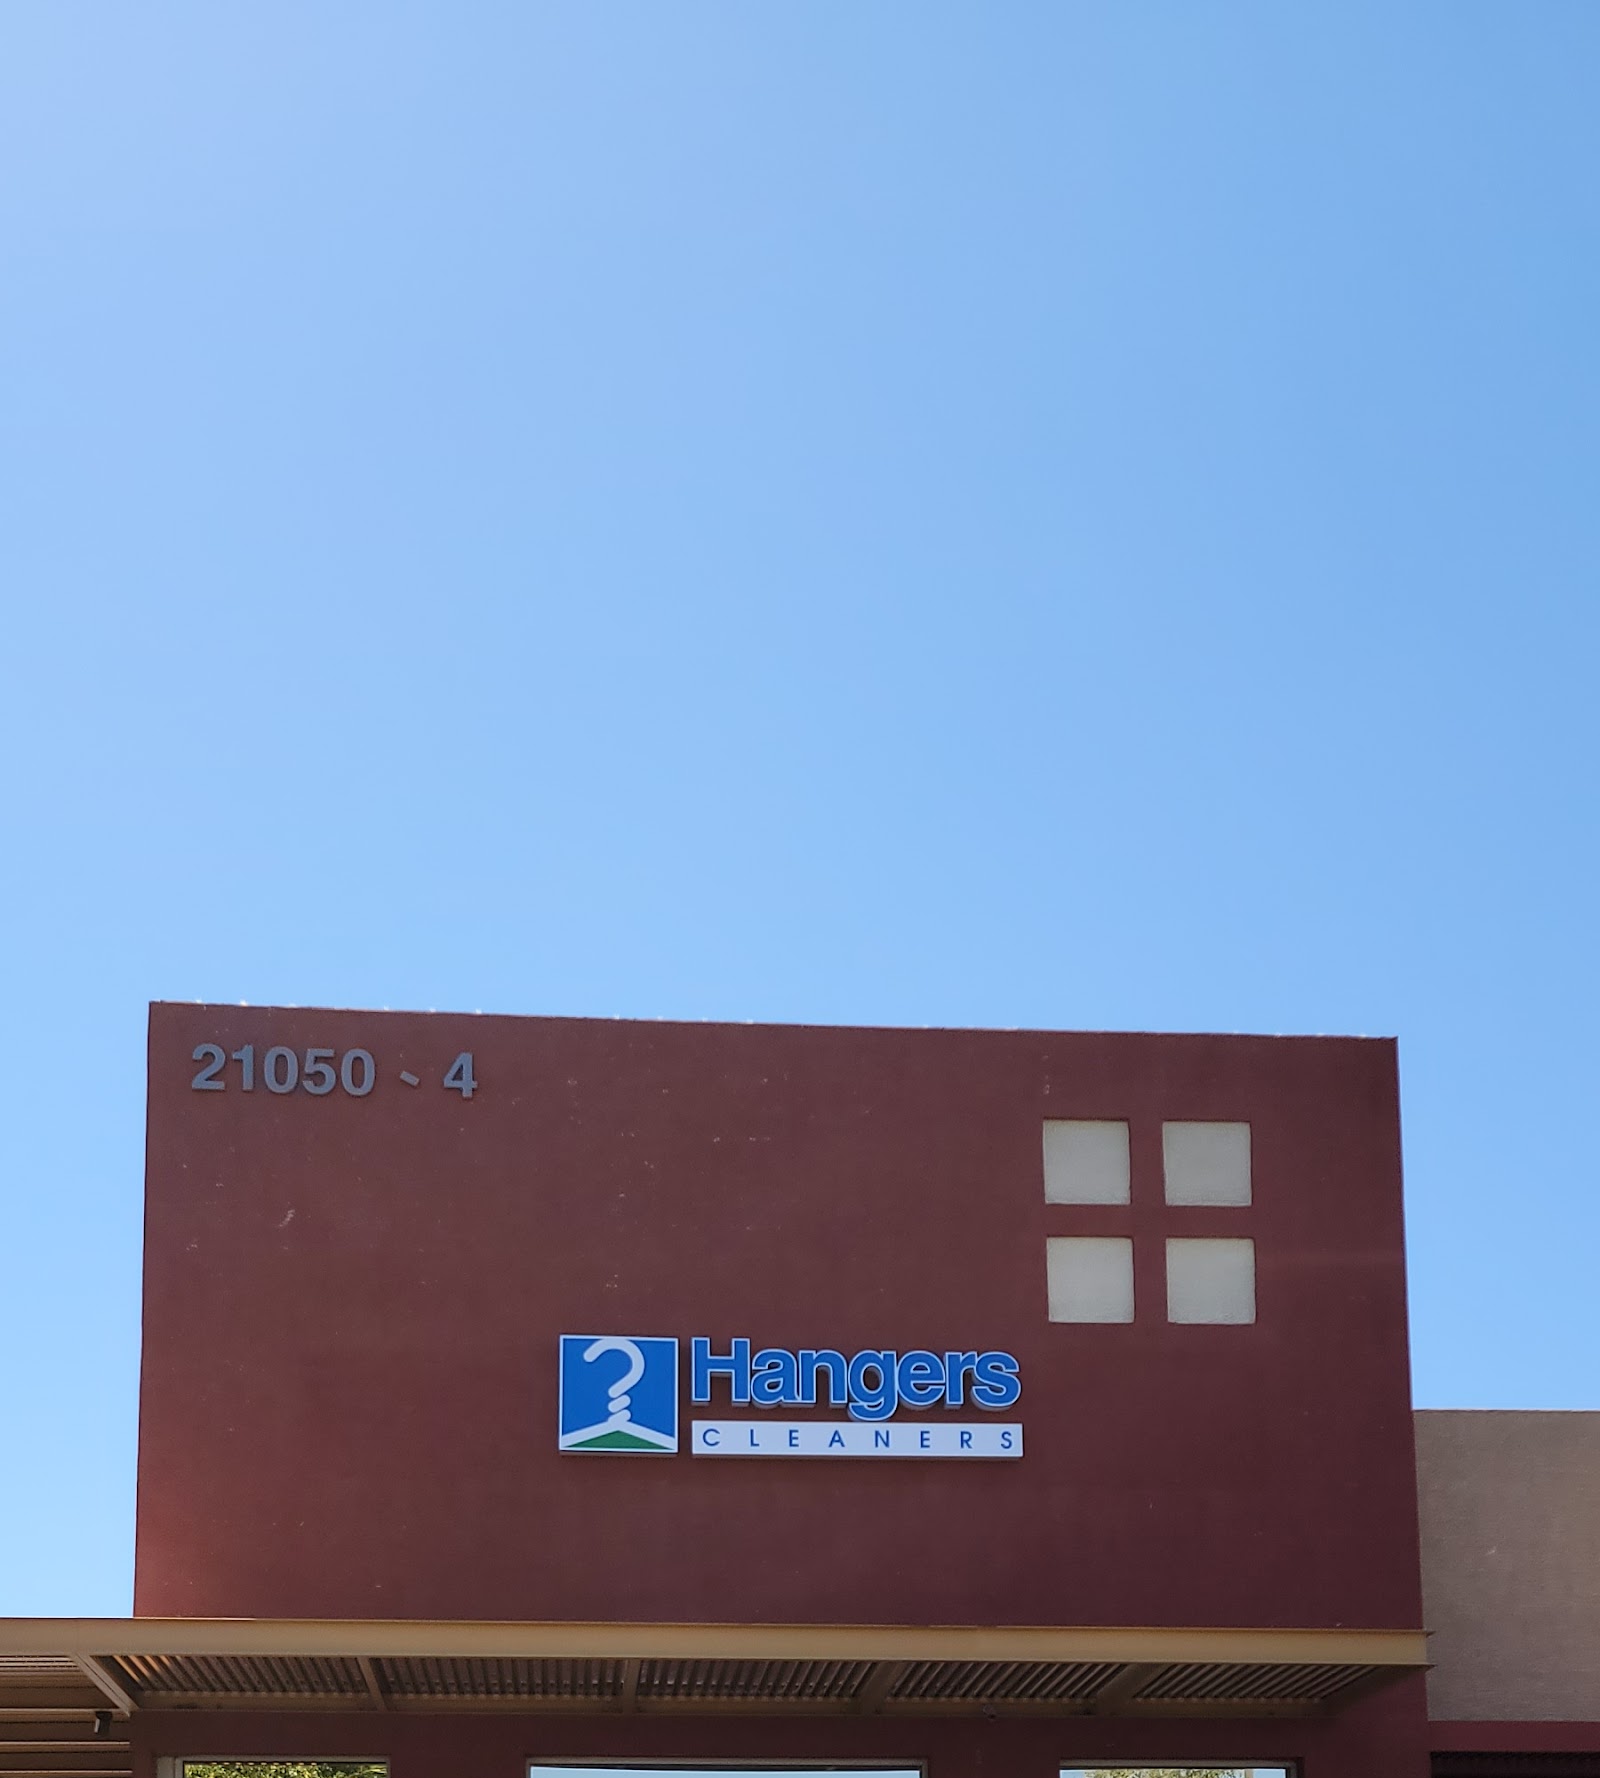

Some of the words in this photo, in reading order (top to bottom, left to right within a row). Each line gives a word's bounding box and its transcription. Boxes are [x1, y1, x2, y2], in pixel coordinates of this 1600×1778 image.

[191, 1043, 376, 1097] 21050
[443, 1052, 478, 1099] 4
[691, 1337, 1022, 1422] Hangers
[702, 1428, 1013, 1450] CLEANERS
